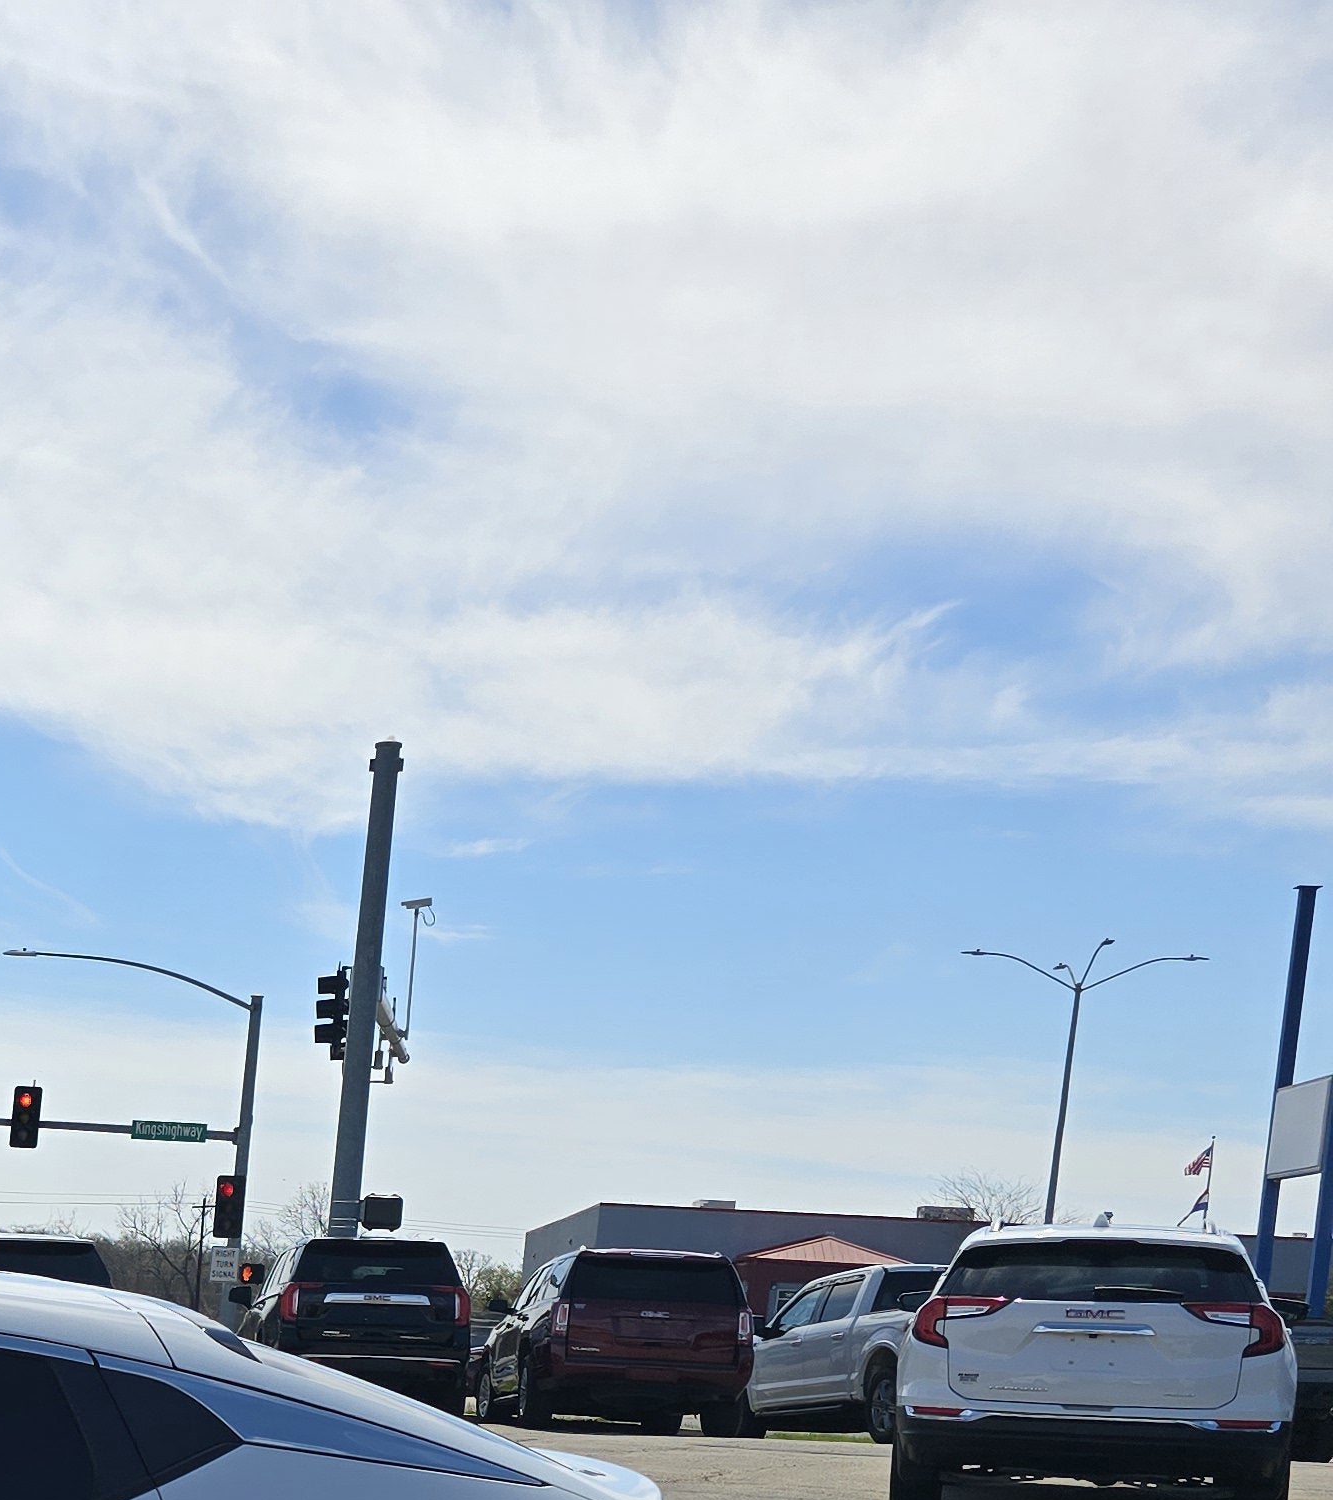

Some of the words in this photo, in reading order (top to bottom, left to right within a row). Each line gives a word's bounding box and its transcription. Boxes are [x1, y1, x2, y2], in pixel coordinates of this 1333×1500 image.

[135, 1121, 203, 1140] Kingshighway
[215, 1250, 236, 1258] RIGHT
[216, 1260, 234, 1268] TURN
[211, 1270, 236, 1279] SIGNAL
[363, 1294, 392, 1302] GMC
[1065, 1309, 1125, 1320] GMC
